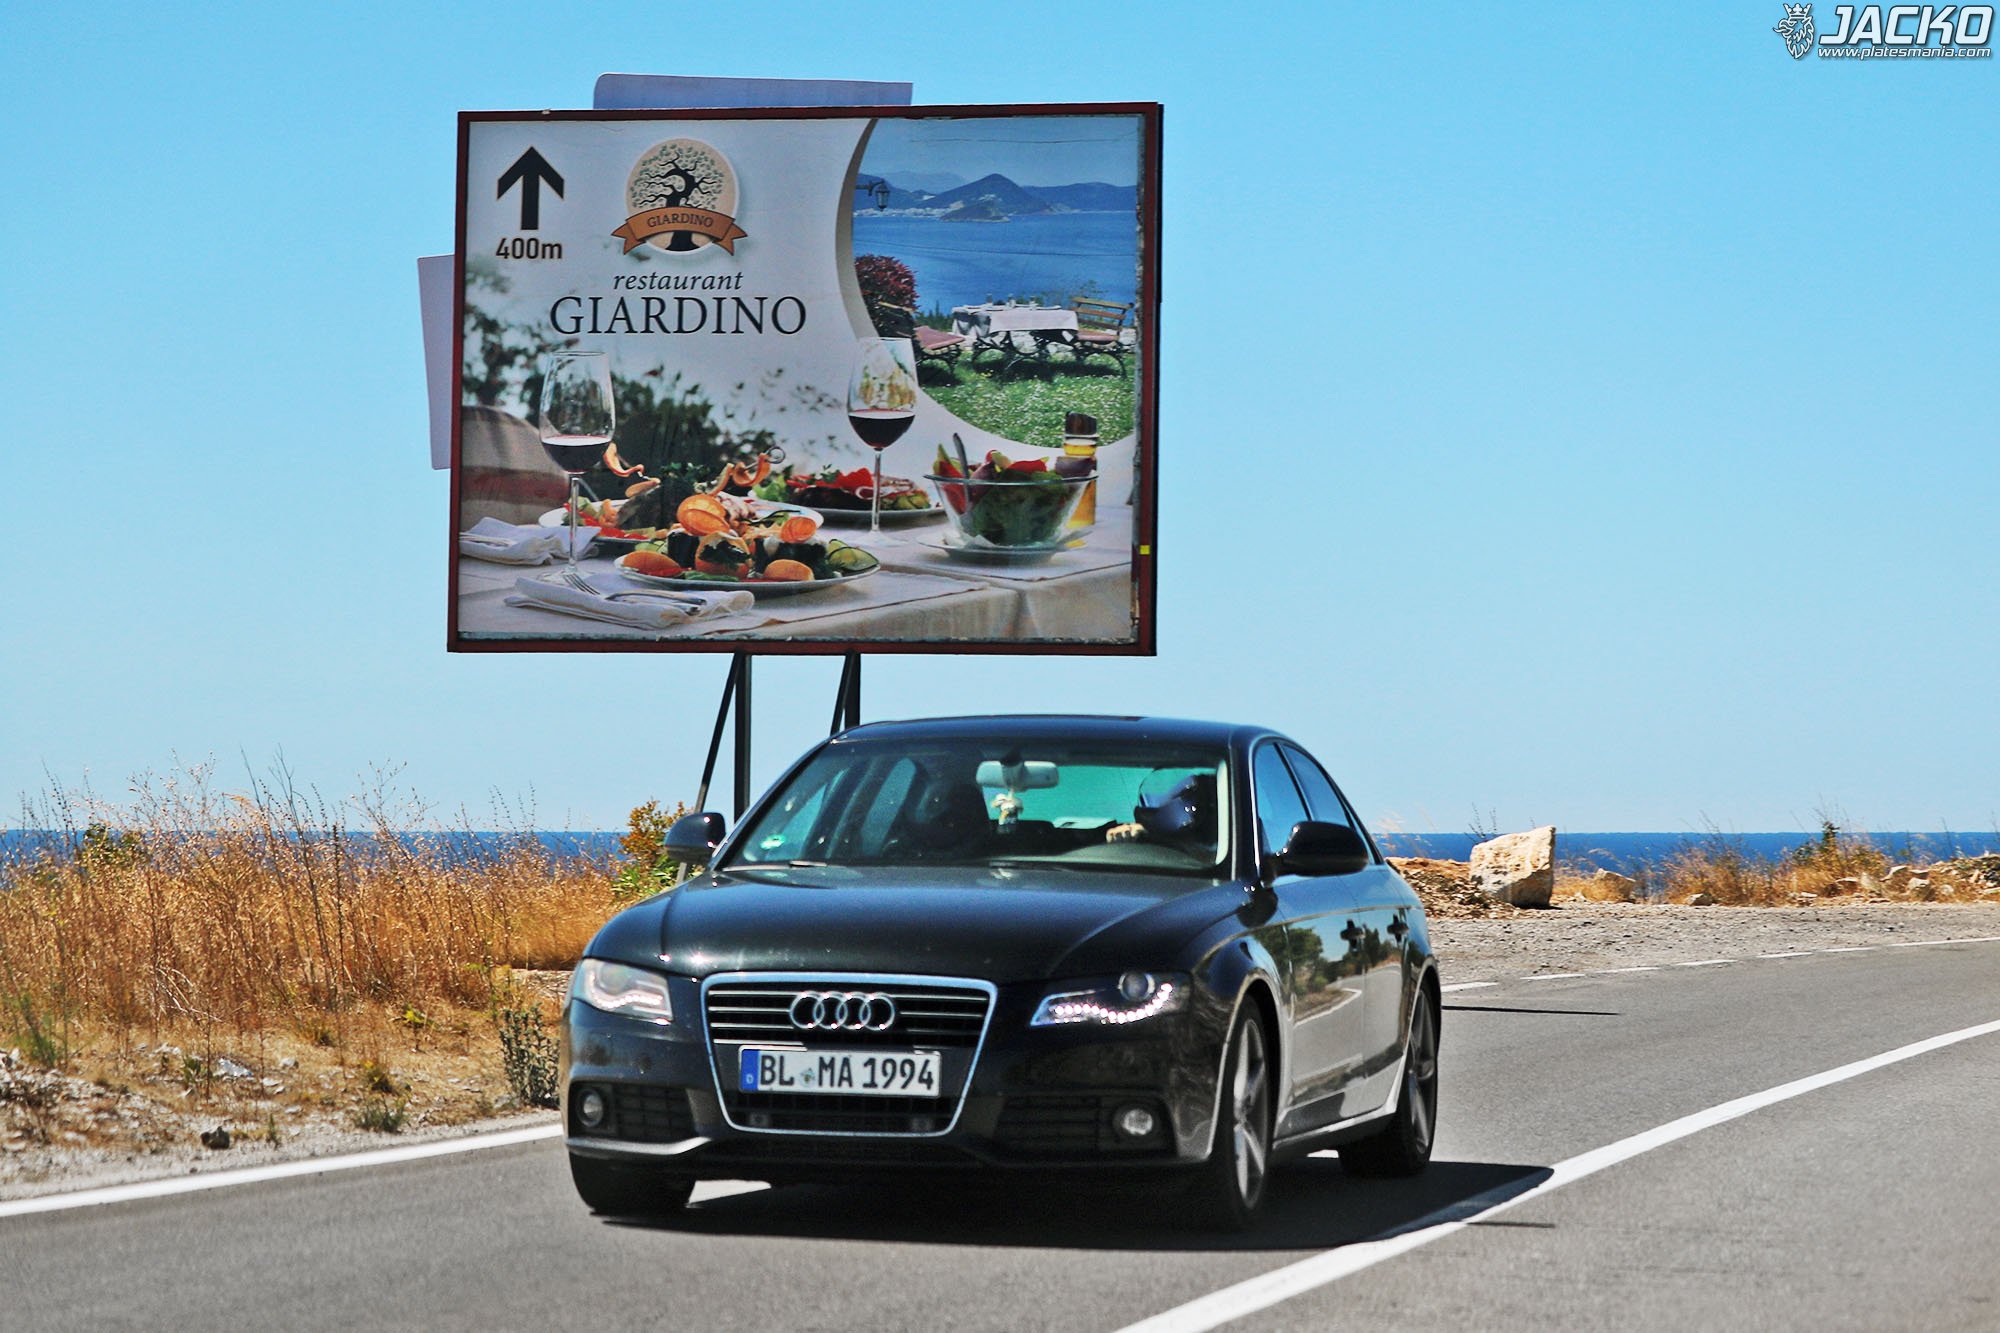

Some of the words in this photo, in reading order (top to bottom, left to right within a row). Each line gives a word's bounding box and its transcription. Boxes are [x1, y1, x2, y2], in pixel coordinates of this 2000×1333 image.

[647, 213, 714, 228] GIARDINO
[495, 237, 563, 259] 400m
[613, 271, 743, 291] restaurant
[549, 296, 807, 335] GIARDINO
[760, 1055, 795, 1086] BL
[818, 1056, 853, 1088] MA
[862, 1057, 934, 1090] 1994
